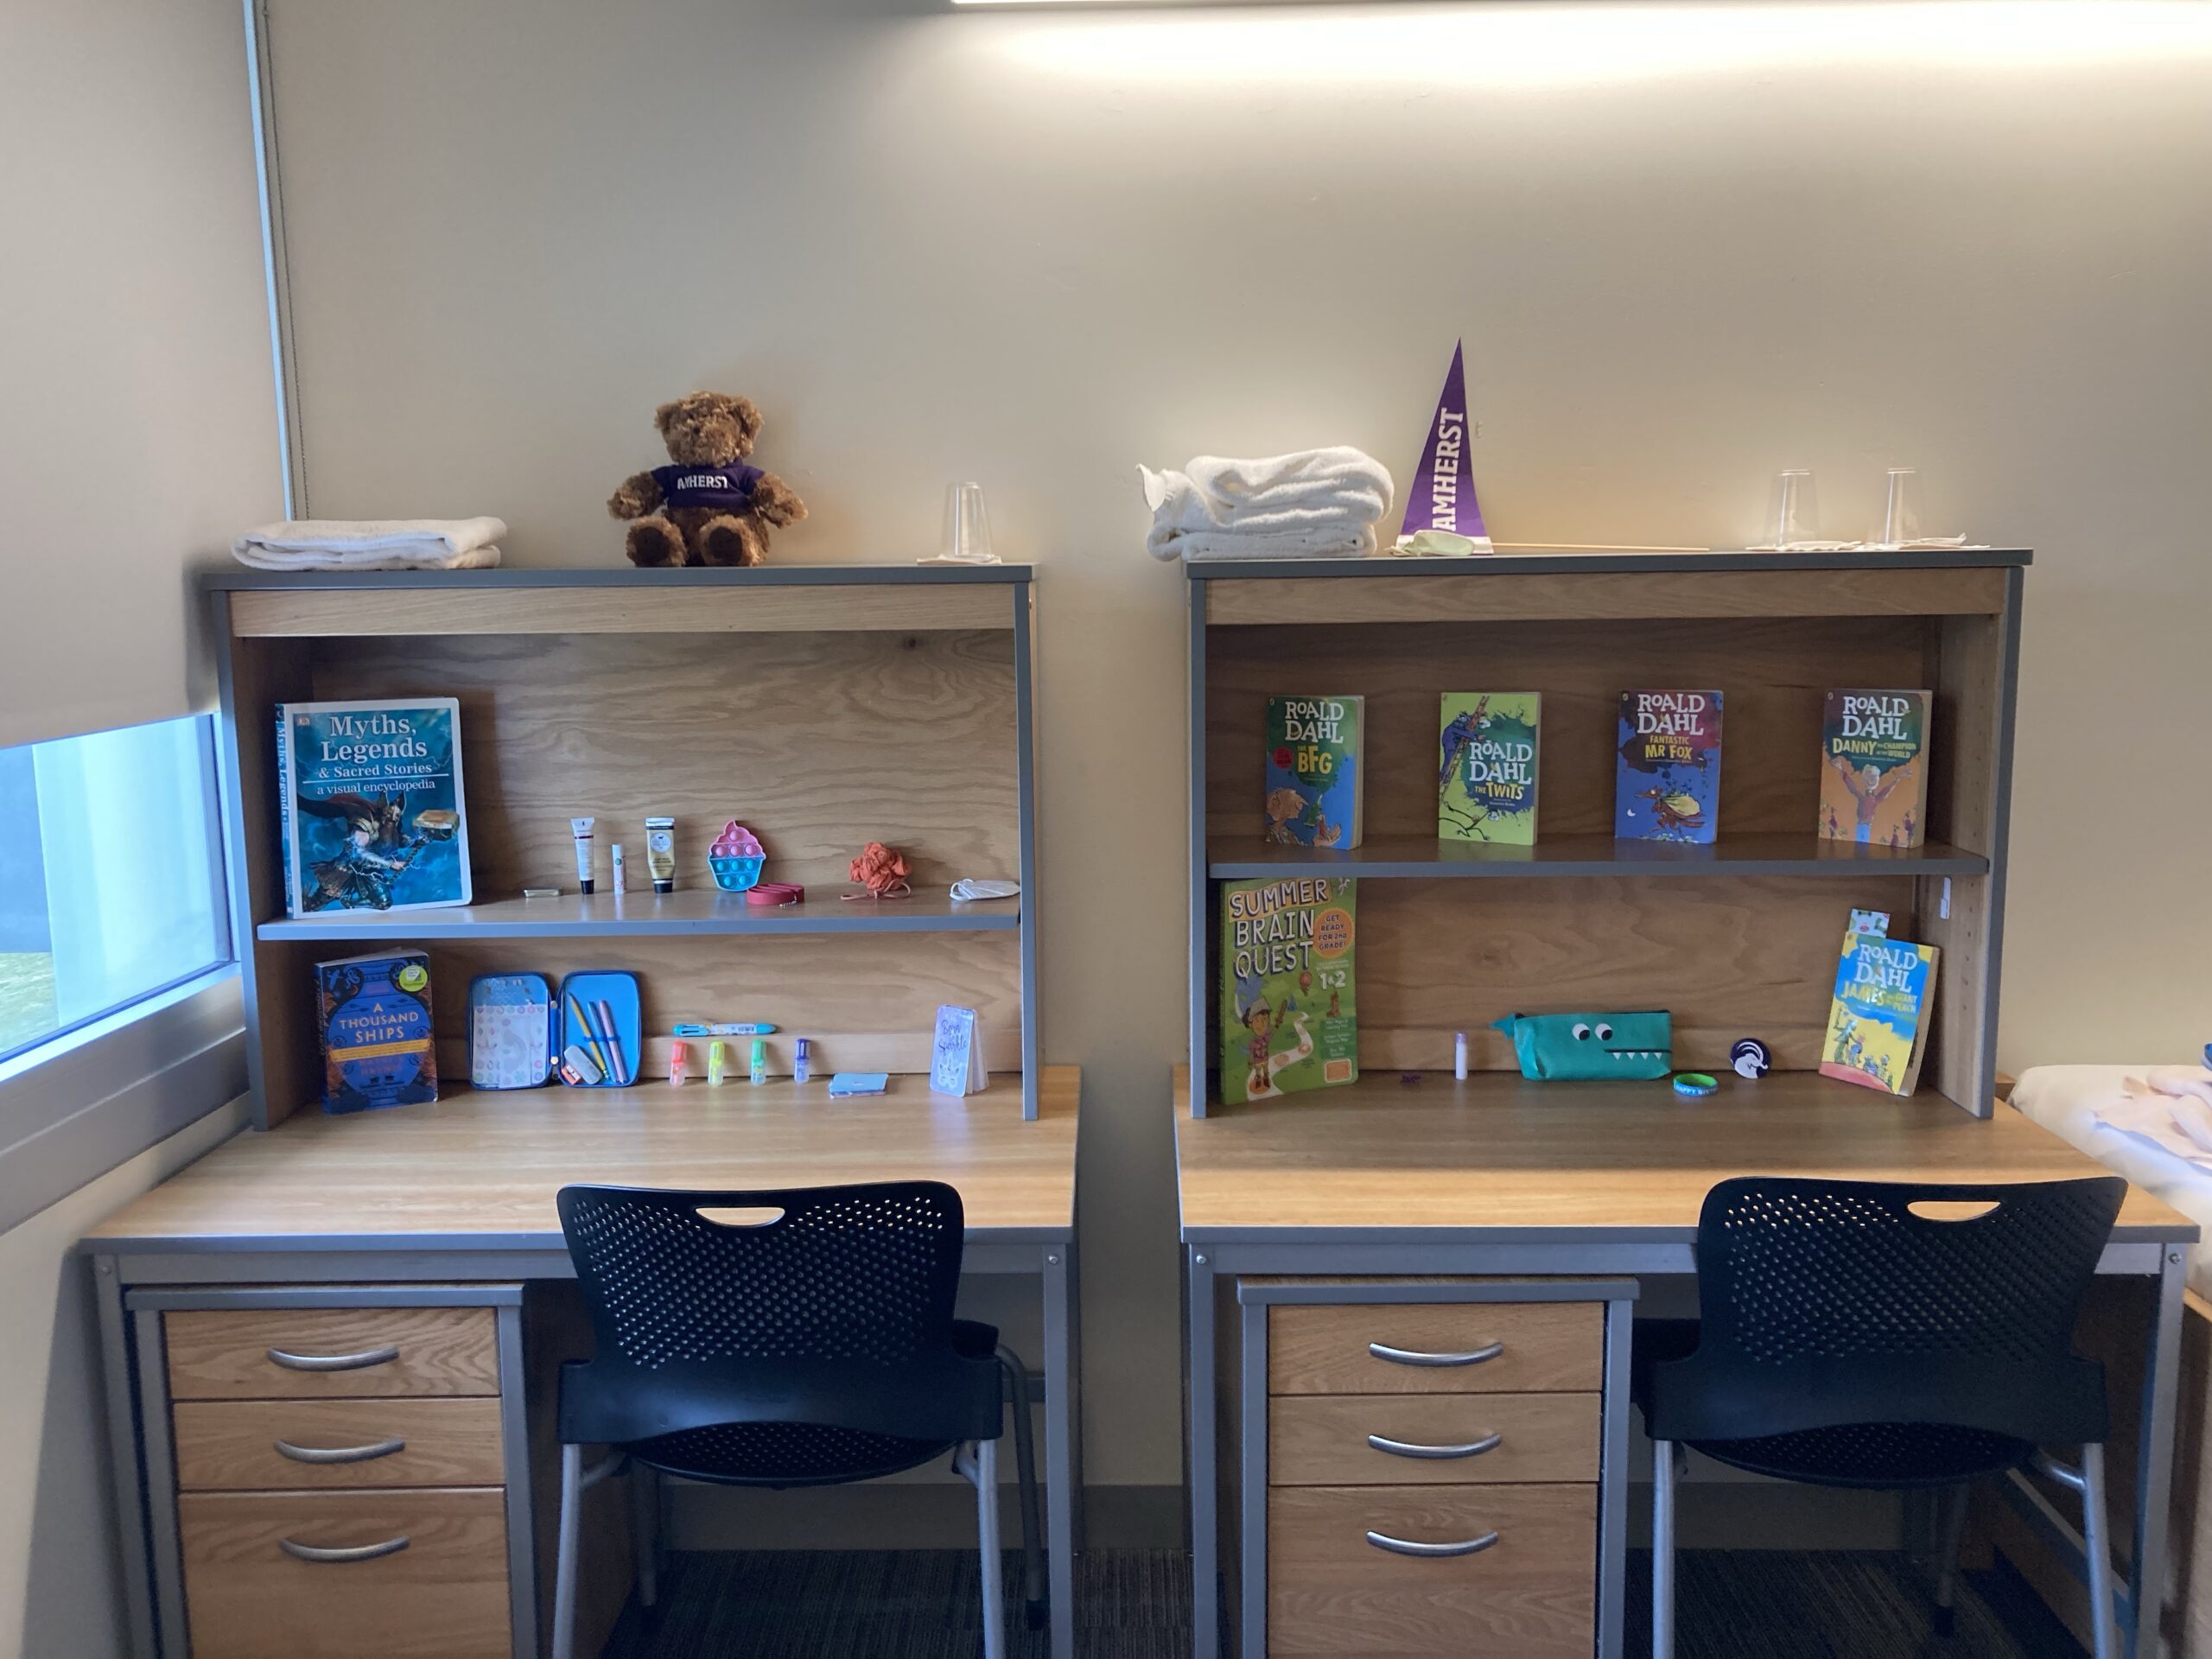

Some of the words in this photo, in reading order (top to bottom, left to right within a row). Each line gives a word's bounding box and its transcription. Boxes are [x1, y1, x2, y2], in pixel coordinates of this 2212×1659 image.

[1432, 407, 1464, 532] AMHERST
[1285, 701, 1344, 721] ROALD
[1637, 693, 1706, 714] ROALD
[1842, 696, 1910, 717] ROALD
[330, 714, 417, 740] Myths,
[1285, 720, 1344, 744] DAHL
[1637, 713, 1705, 736] DAHL
[1841, 715, 1907, 741] DAHL
[321, 737, 428, 763] Legends
[1649, 734, 1690, 745] FANTASTIC
[1832, 737, 1878, 756] DANNY
[1298, 745, 1332, 774] BFG
[1469, 741, 1533, 762] ROALD
[1644, 744, 1665, 759] MR
[1669, 744, 1693, 760] FOX
[319, 768, 330, 779] &
[334, 765, 380, 778] Sacred
[384, 763, 433, 776] Stories
[1469, 760, 1532, 785] DAHL
[279, 768, 290, 817] Legends
[327, 783, 361, 794] visual
[363, 779, 435, 794] encyclopedia
[1475, 785, 1487, 794] THE
[1485, 781, 1525, 800] TWITS
[1230, 878, 1329, 918] SUMMER
[1236, 909, 1315, 947] BRAIN
[1319, 933, 1332, 942] FOR
[1320, 923, 1344, 932] READY
[1319, 941, 1346, 950] GRADE!
[1235, 940, 1314, 979] QUEST
[1858, 944, 1918, 971] ROALD
[1854, 961, 1913, 994] DAHL
[1840, 980, 1887, 1007] JAMES
[372, 1002, 384, 1013] A
[338, 1012, 419, 1029] THOUSAND
[355, 1026, 404, 1044] SHIPS
